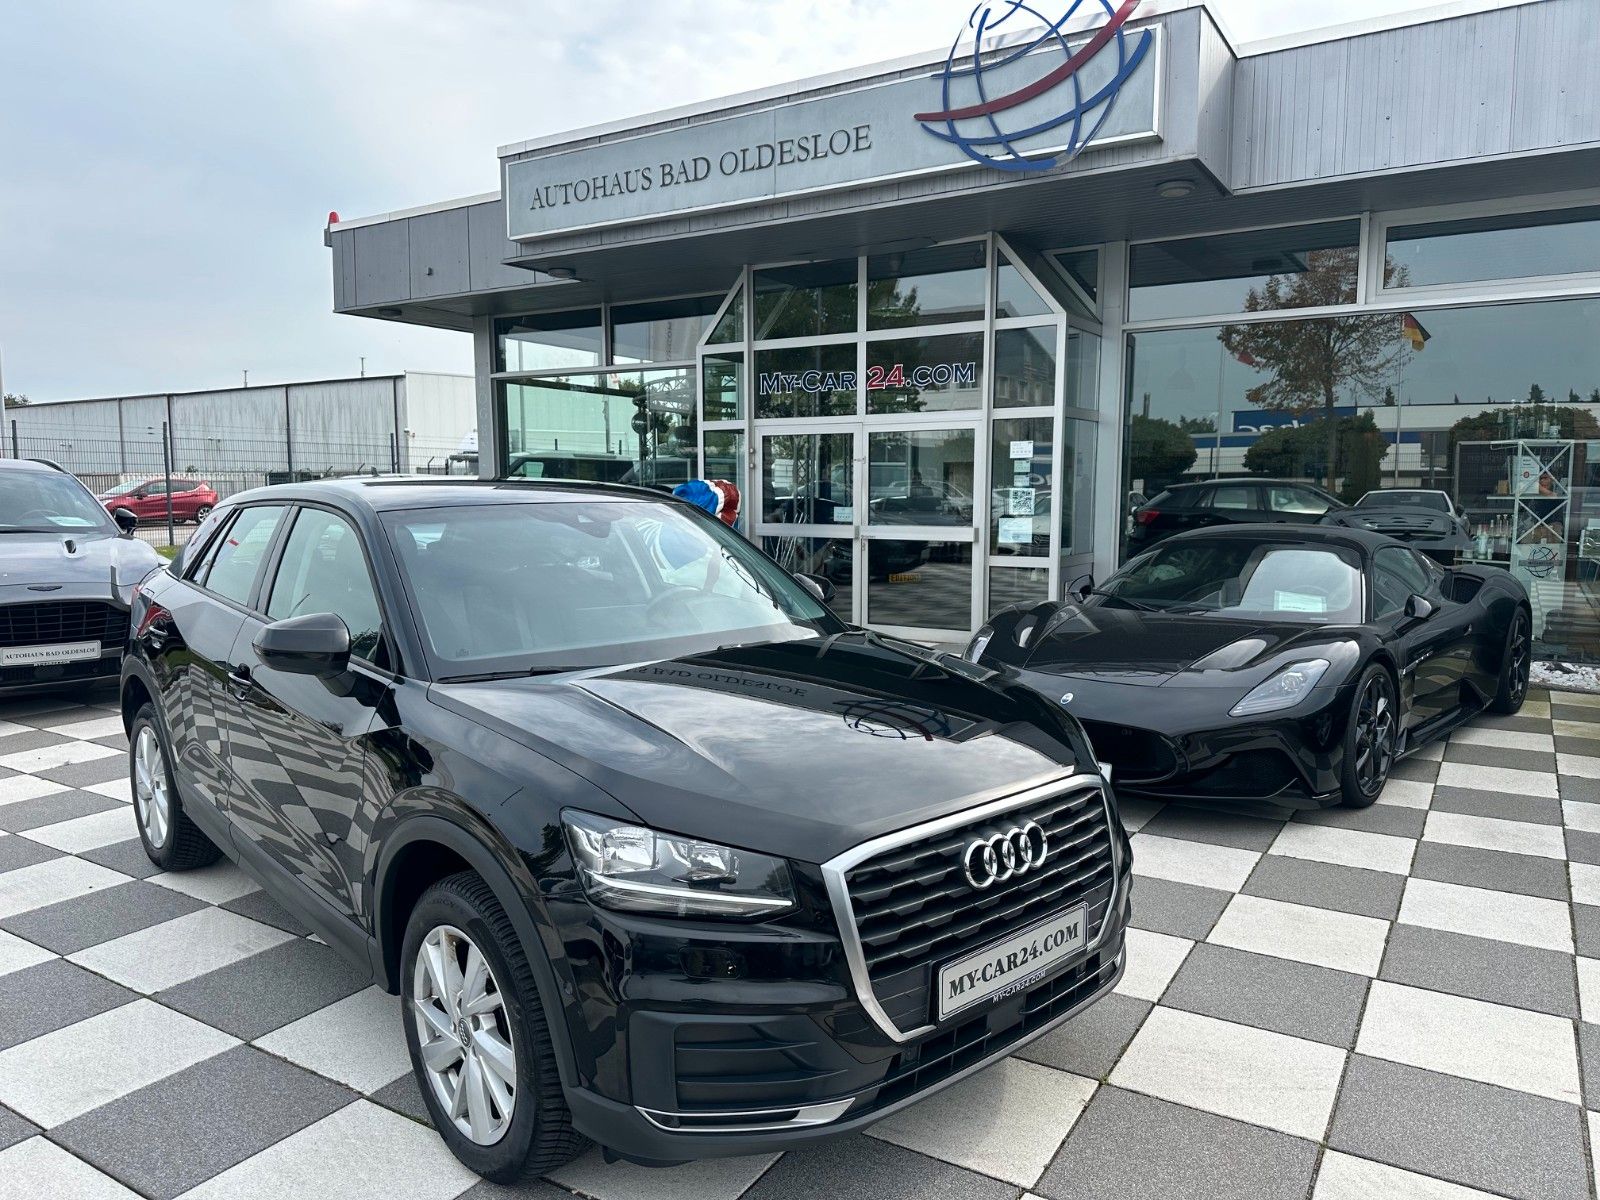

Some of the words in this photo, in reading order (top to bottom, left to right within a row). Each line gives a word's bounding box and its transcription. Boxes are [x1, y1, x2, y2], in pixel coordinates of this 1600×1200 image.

[530, 167, 653, 210] AUTOHAUS
[660, 156, 711, 188] BAD
[719, 124, 873, 176] OLDESLOE
[948, 921, 1080, 999] MY-CAR24.COM
[991, 969, 1047, 1003] MY-CAR24.COM
